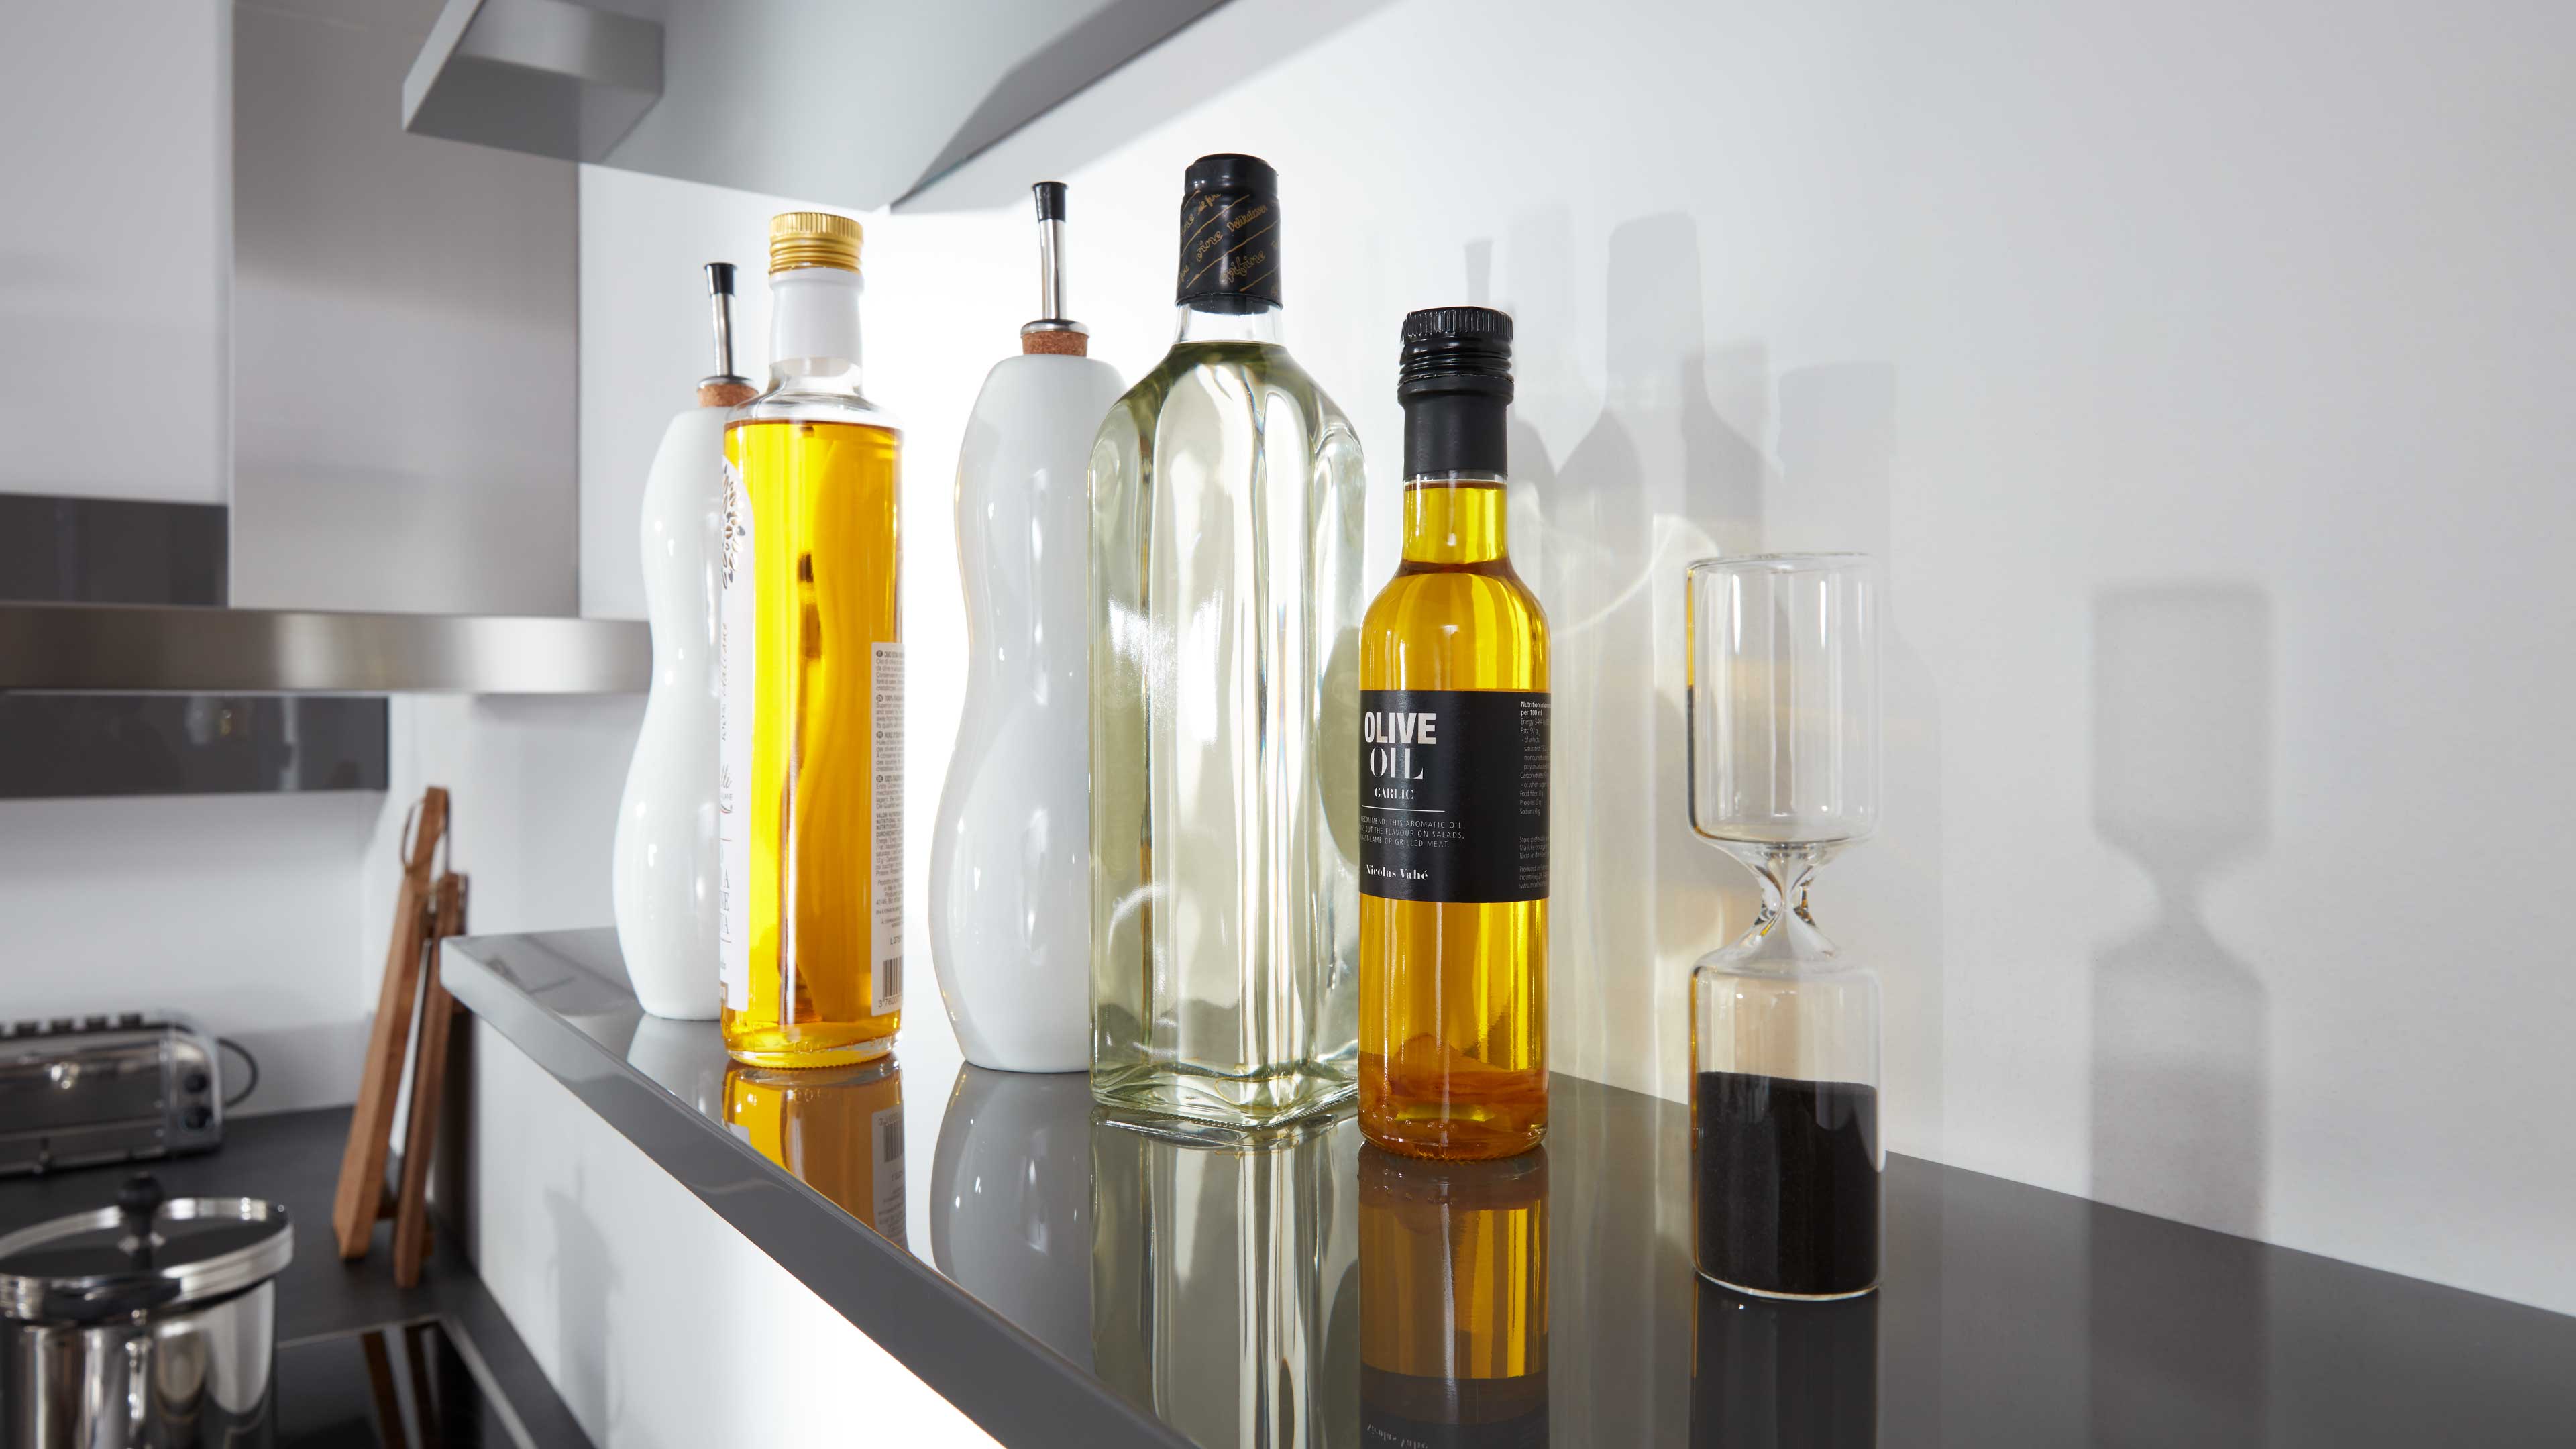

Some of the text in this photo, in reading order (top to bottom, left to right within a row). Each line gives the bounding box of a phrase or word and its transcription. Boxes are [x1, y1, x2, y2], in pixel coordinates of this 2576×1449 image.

[1364, 711, 1436, 744] OLIVE
[1370, 747, 1424, 780] OIL
[1375, 787, 1413, 800] GARLIC
[1406, 820, 1445, 828] AROMATIC
[1374, 826, 1383, 835] THE
[1385, 828, 1414, 837] FLAVOUR
[1432, 830, 1464, 839] SALADS,
[1366, 864, 1428, 881] Nicolas Vahé
